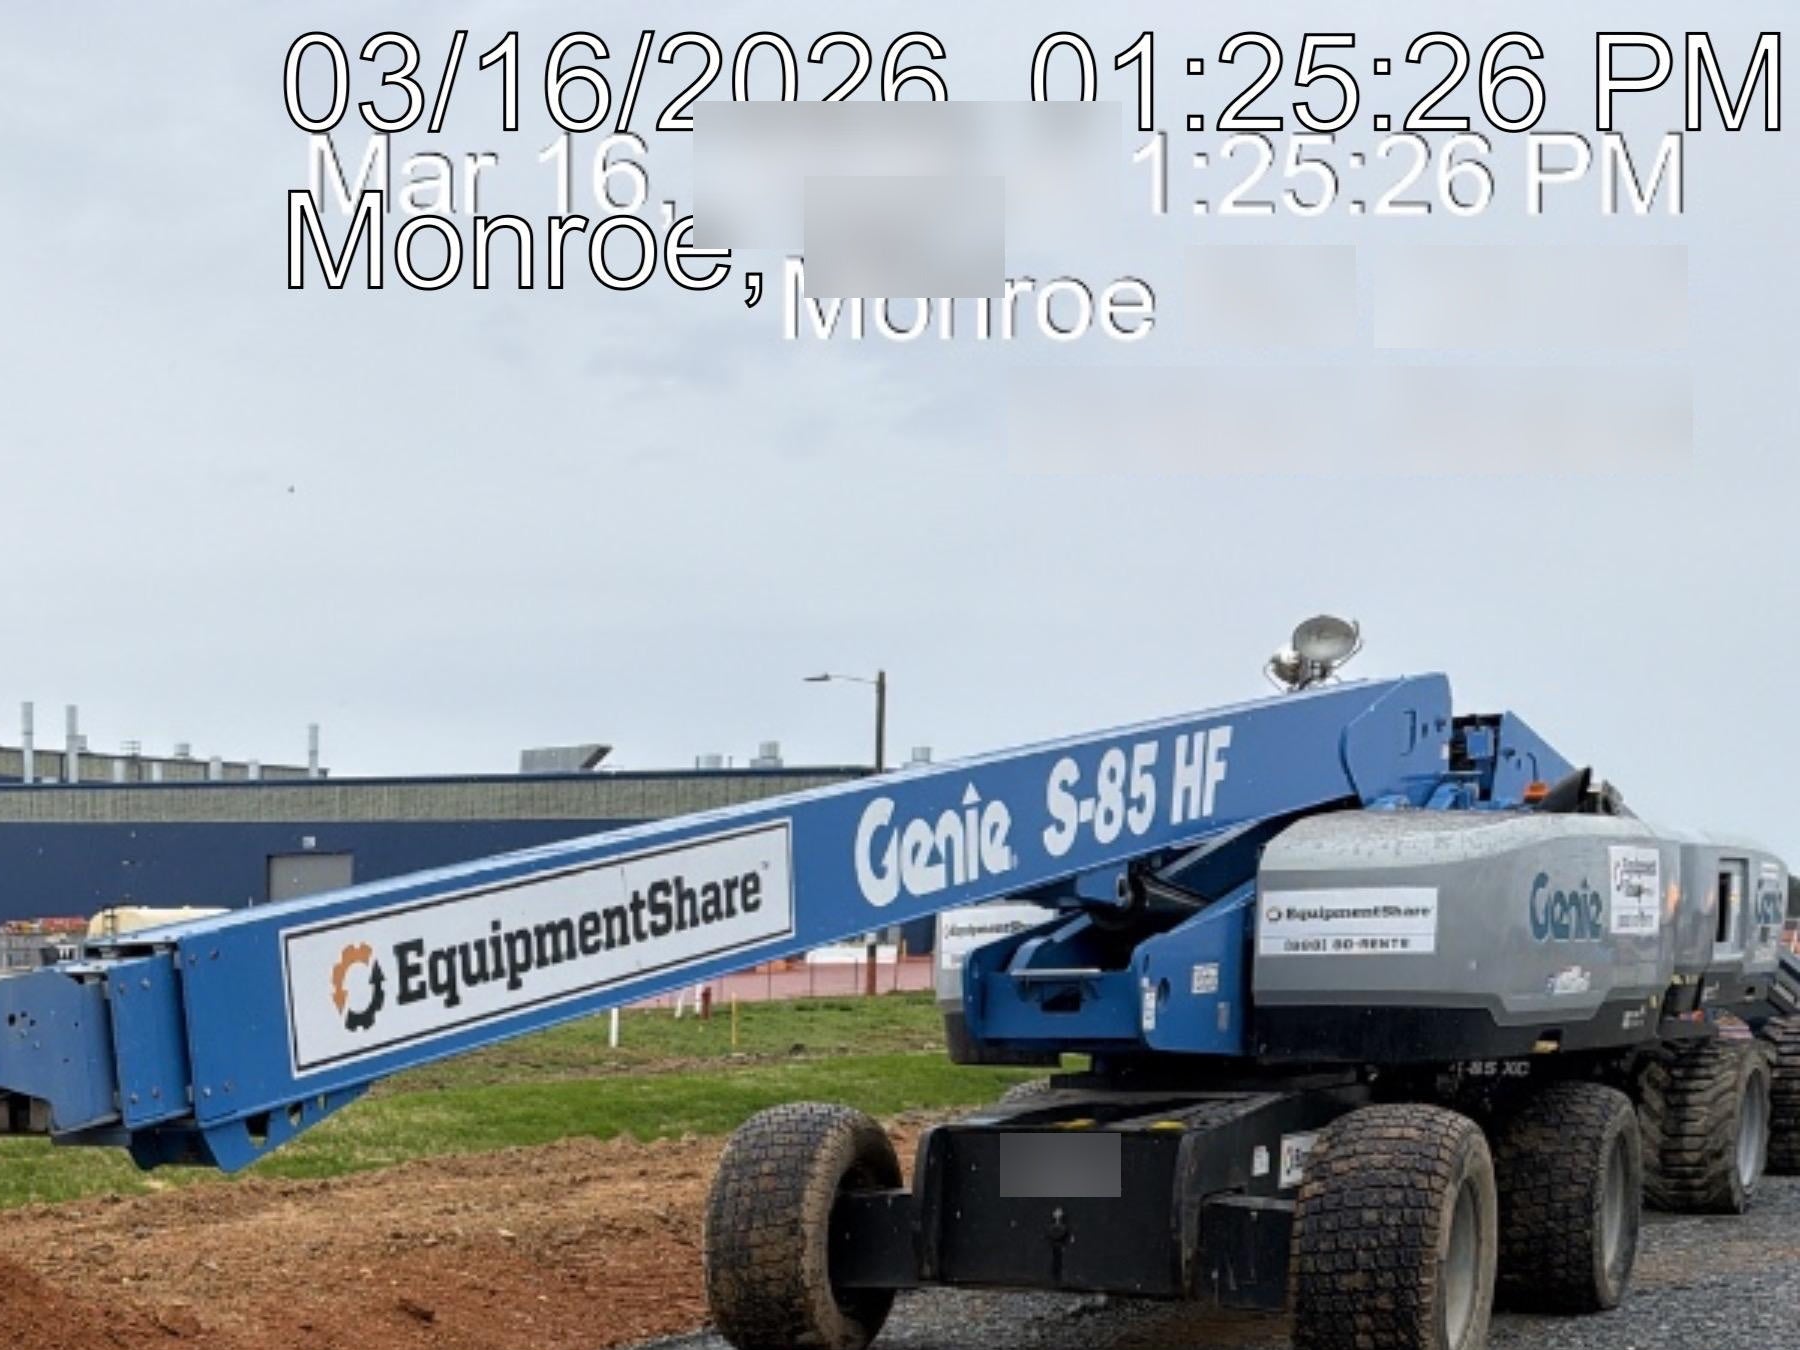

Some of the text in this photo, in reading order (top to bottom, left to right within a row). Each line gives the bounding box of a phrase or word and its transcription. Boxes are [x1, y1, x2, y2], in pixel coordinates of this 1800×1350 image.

[854, 725, 1234, 908] Genie S-85 HF
[392, 870, 764, 1009] EquipmentShare
[1528, 870, 1604, 942] Genie
